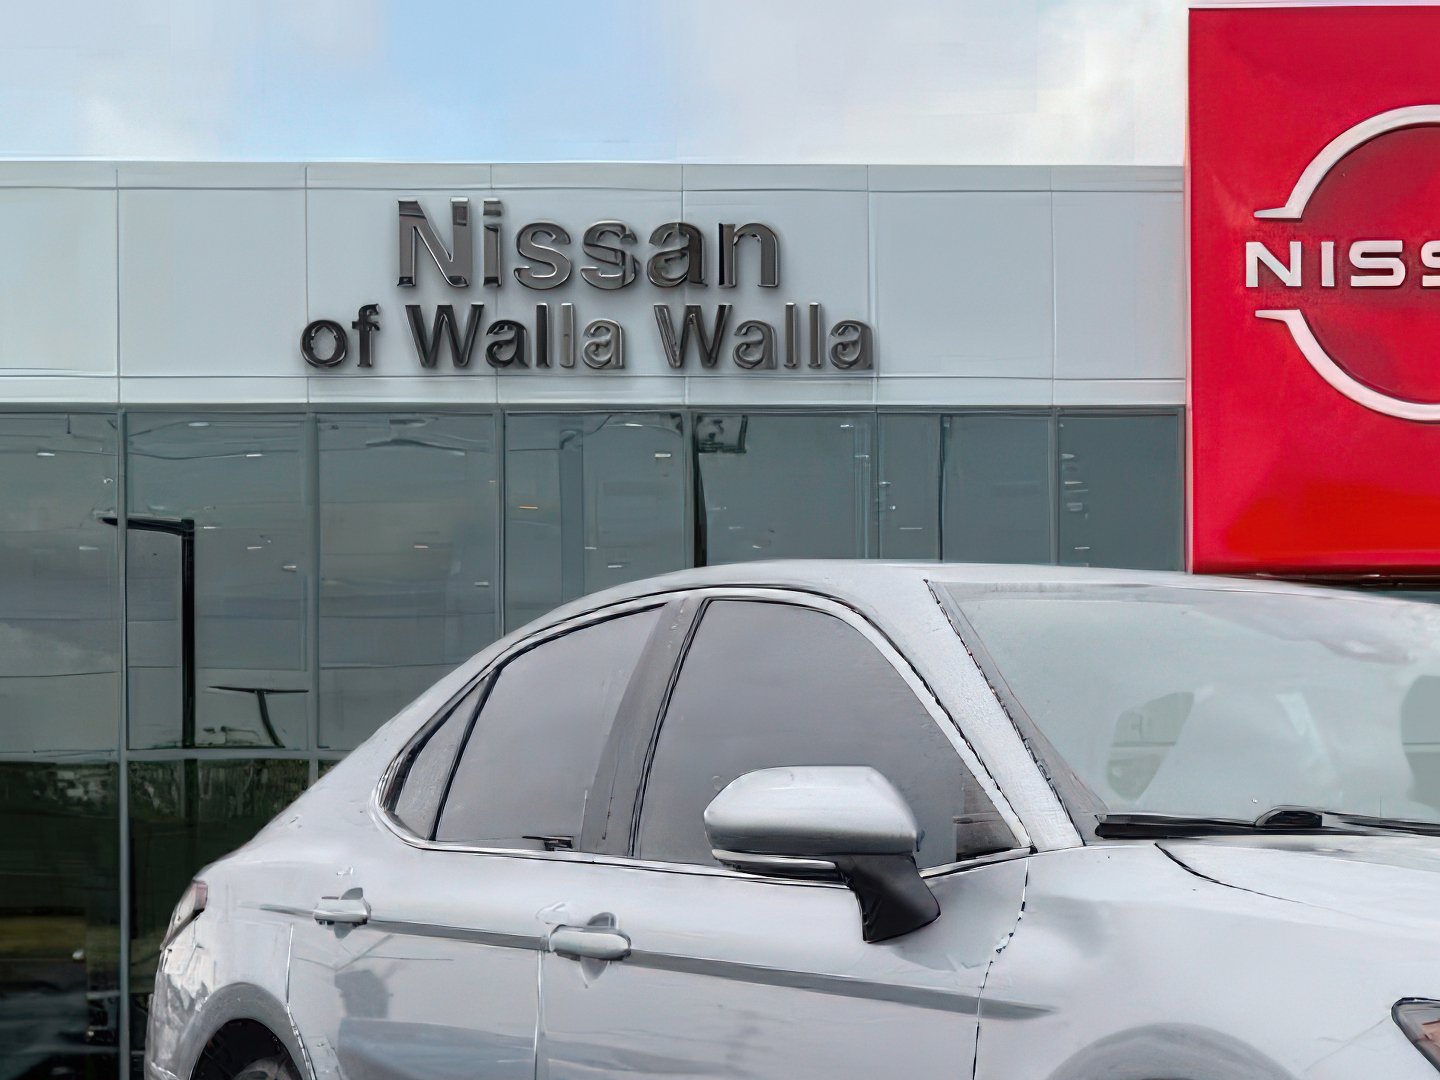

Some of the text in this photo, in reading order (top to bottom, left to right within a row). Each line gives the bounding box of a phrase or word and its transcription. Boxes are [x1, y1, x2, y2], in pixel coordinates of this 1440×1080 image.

[397, 198, 781, 290] Nissan
[300, 303, 874, 371] of Walla Walla
